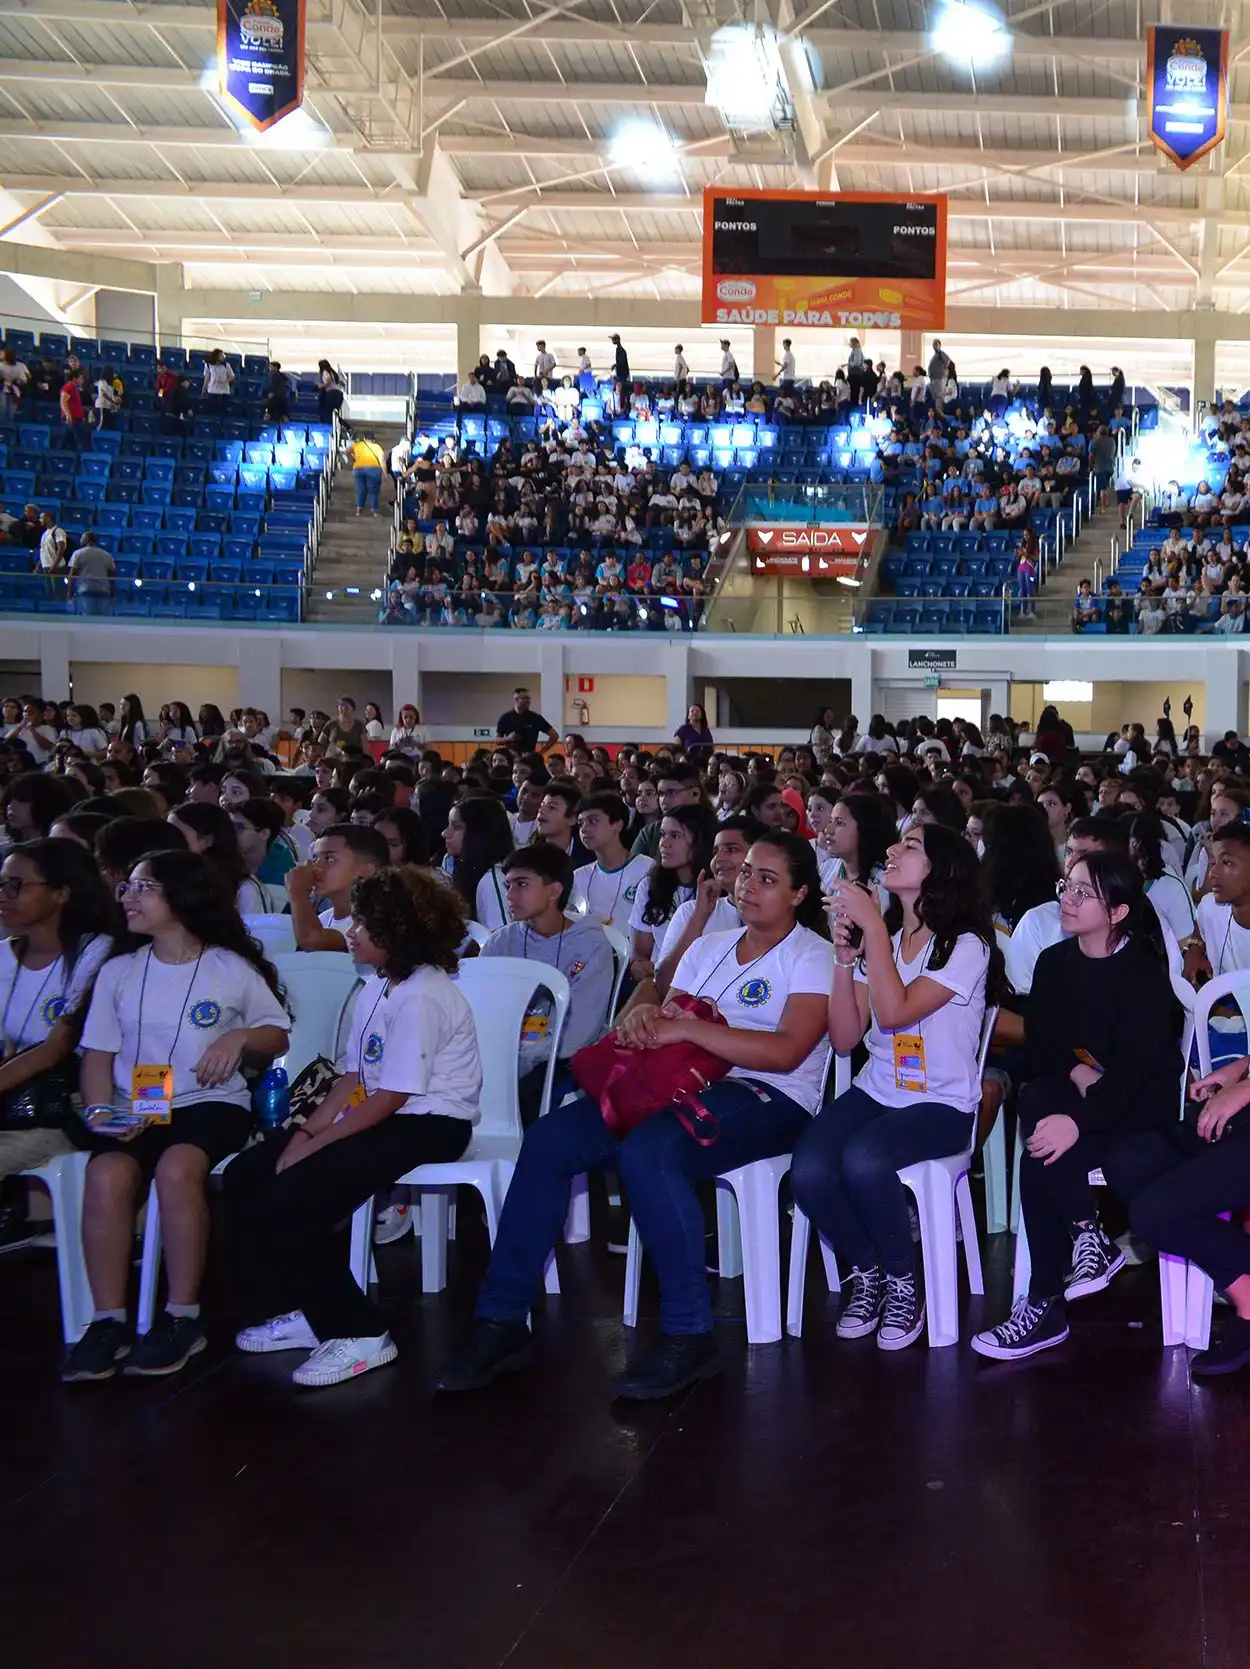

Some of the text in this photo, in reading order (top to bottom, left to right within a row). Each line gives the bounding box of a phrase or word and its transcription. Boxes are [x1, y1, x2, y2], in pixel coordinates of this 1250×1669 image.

[715, 221, 757, 231] PONTOS
[893, 225, 935, 235] PONTOS
[716, 305, 779, 324] SAÚDE
[783, 309, 834, 325] PARA
[782, 530, 842, 546] SAÍDA
